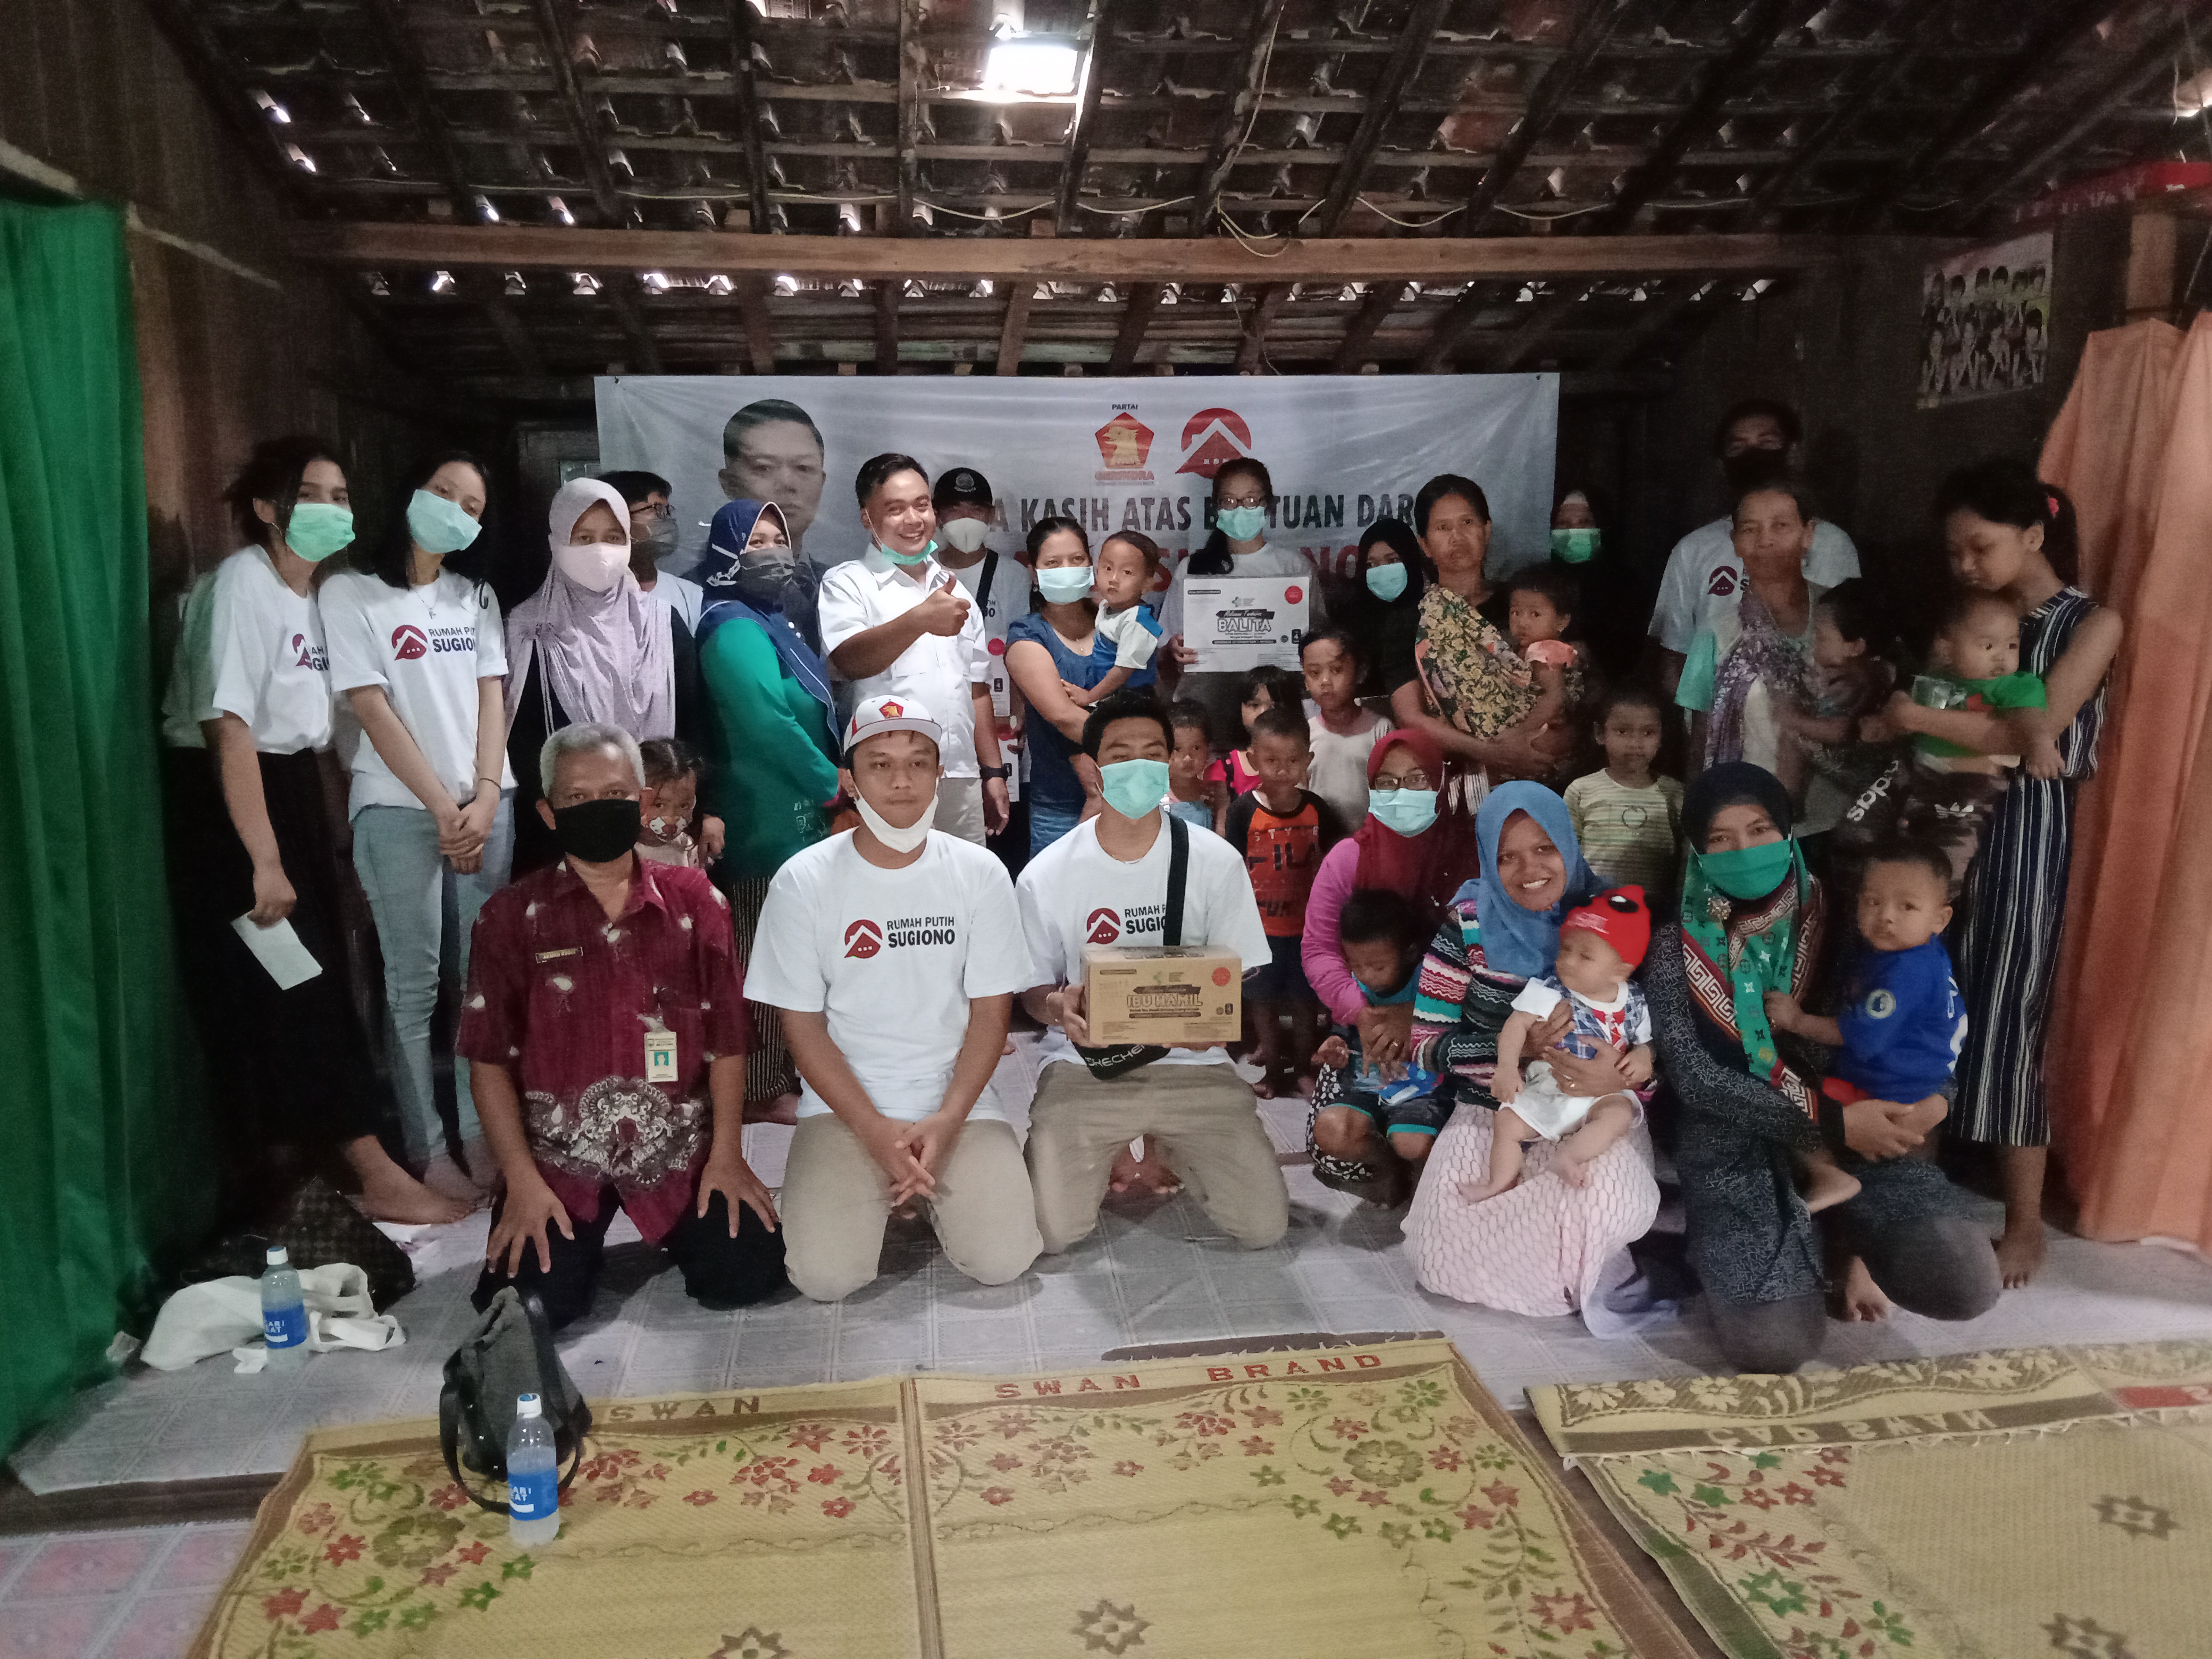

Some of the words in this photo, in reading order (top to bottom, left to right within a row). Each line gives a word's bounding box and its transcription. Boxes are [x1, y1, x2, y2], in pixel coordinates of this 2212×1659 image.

[1021, 497, 1109, 532] KASIH
[1121, 496, 1191, 531] ATAS
[1204, 494, 1344, 530] BTUAN
[1357, 494, 1415, 527] DAR
[428, 627, 463, 636] RUMAH
[1218, 618, 1271, 632] BALITA
[432, 638, 475, 652] SUGIO
[1125, 905, 1160, 918] RUMAH
[887, 918, 921, 931] RUMAH
[925, 916, 954, 927] PUTIH
[1126, 916, 1166, 934] SUGI
[888, 929, 955, 948] SUGIONO
[1127, 994, 1152, 1008] IBU
[1155, 992, 1203, 1007] HAMIL
[1085, 1044, 1145, 1067] SKECHE
[994, 1374, 1141, 1398] SWAN
[1206, 1355, 1381, 1381] BRAND
[610, 1396, 760, 1421] SWAN
